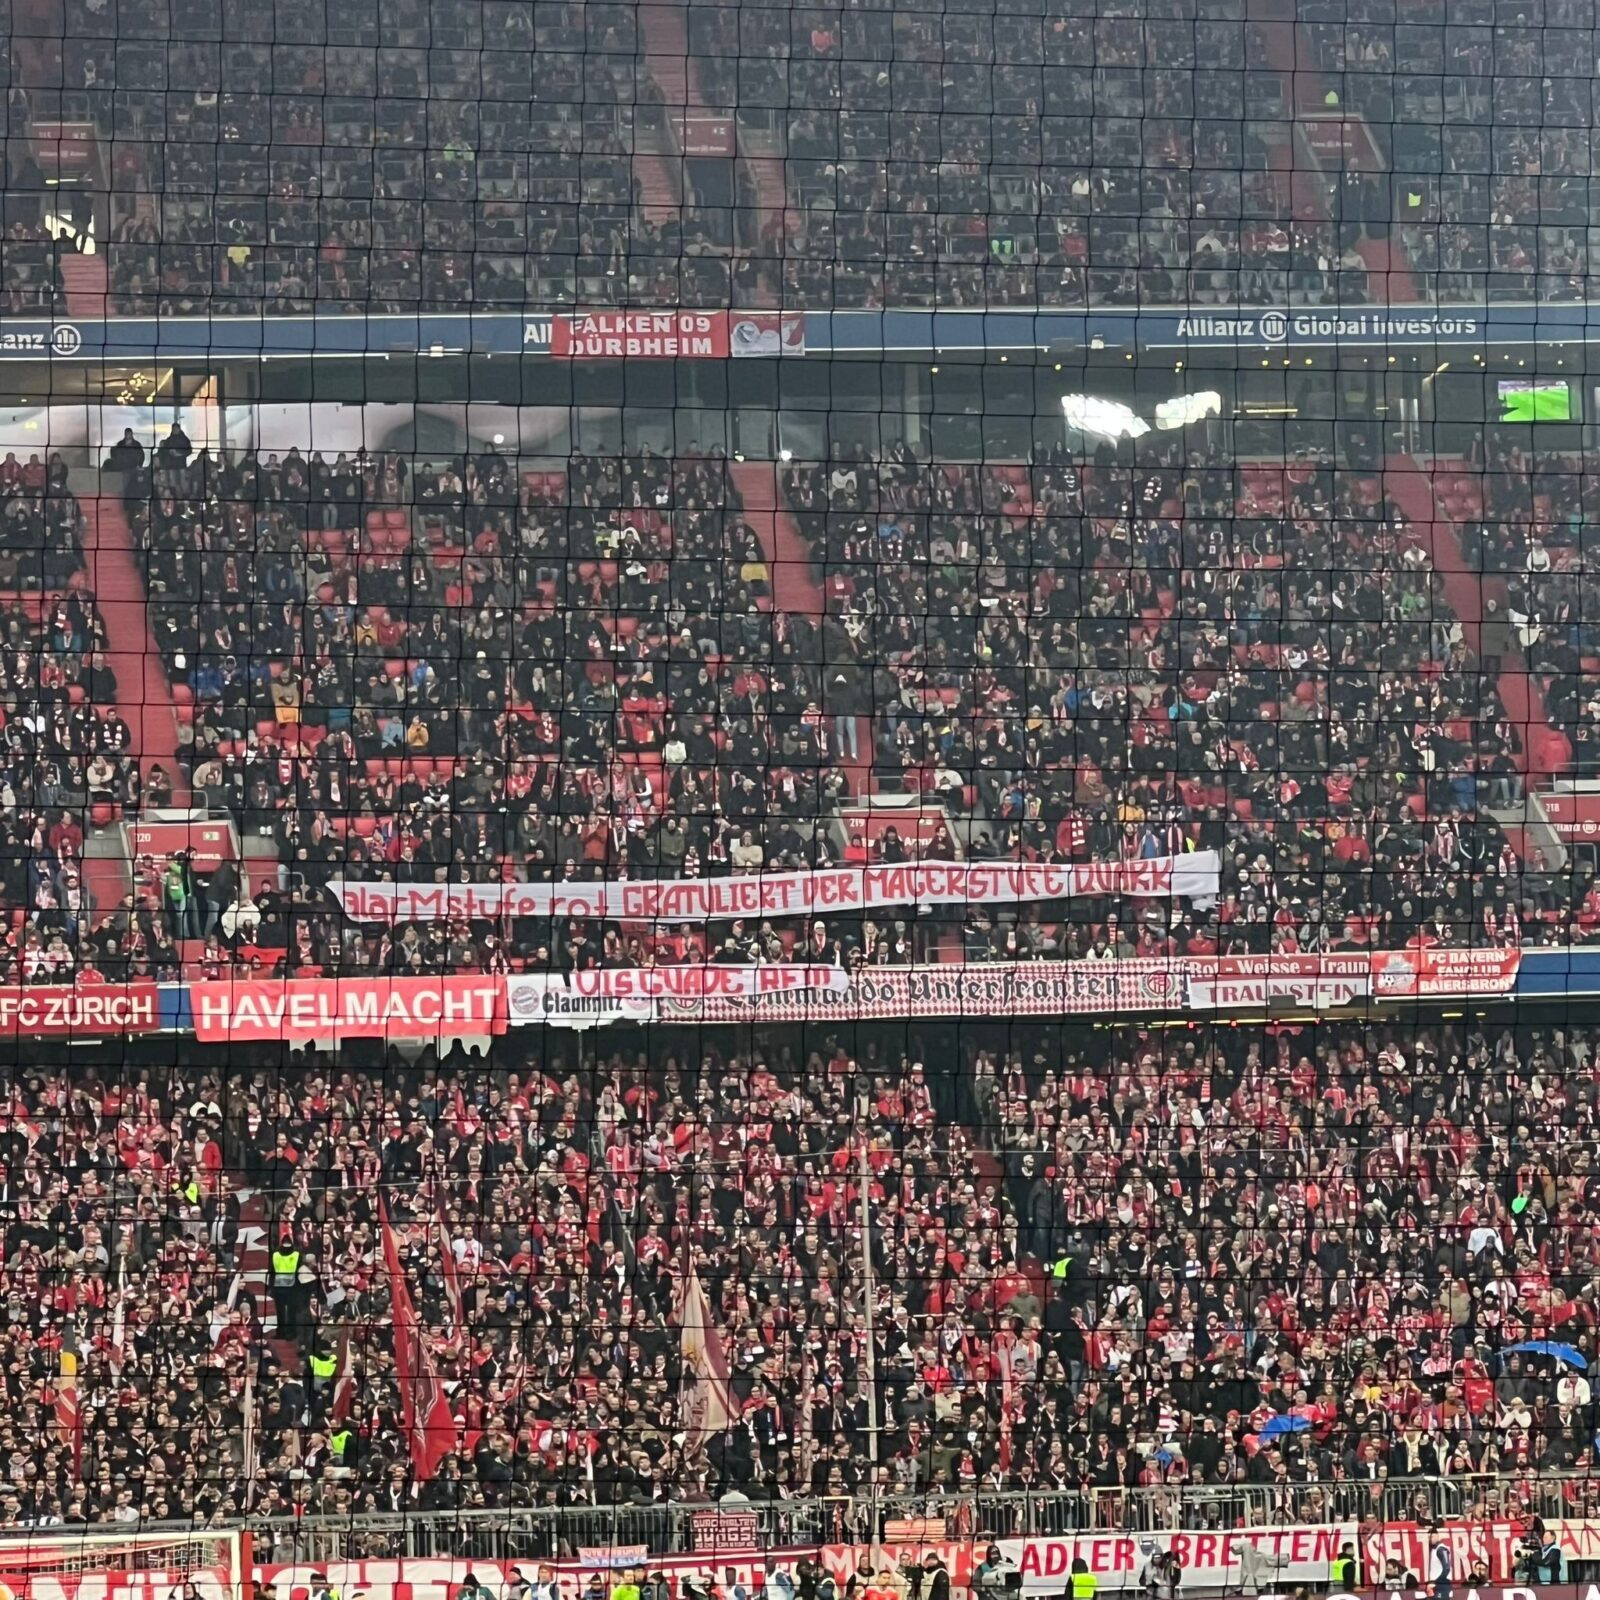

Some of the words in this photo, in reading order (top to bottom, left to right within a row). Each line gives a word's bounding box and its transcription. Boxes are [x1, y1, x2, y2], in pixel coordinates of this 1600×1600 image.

[1177, 316, 1254, 337] Allianz
[1294, 315, 1366, 335] Global
[1373, 314, 1476, 334] Investors
[568, 334, 712, 355] DÜRBHEIM
[849, 818, 865, 827] 219
[549, 889, 609, 917] rot
[622, 879, 796, 917] GRATULIERT
[803, 873, 858, 906] DER
[1237, 960, 1300, 975] Weisse
[1320, 958, 1369, 974] Traun
[1429, 953, 1448, 964] FC
[1437, 965, 1501, 976] FANCLUB
[910, 971, 1120, 1008] Unterfranken
[1205, 983, 1357, 1003] TRAUNSTEIN
[44, 994, 152, 1026] ZÜRICH
[201, 989, 499, 1029] HAVELMACHT
[695, 1527, 756, 1542] JUNGS!
[1170, 1529, 1341, 1568] BRETTEN
